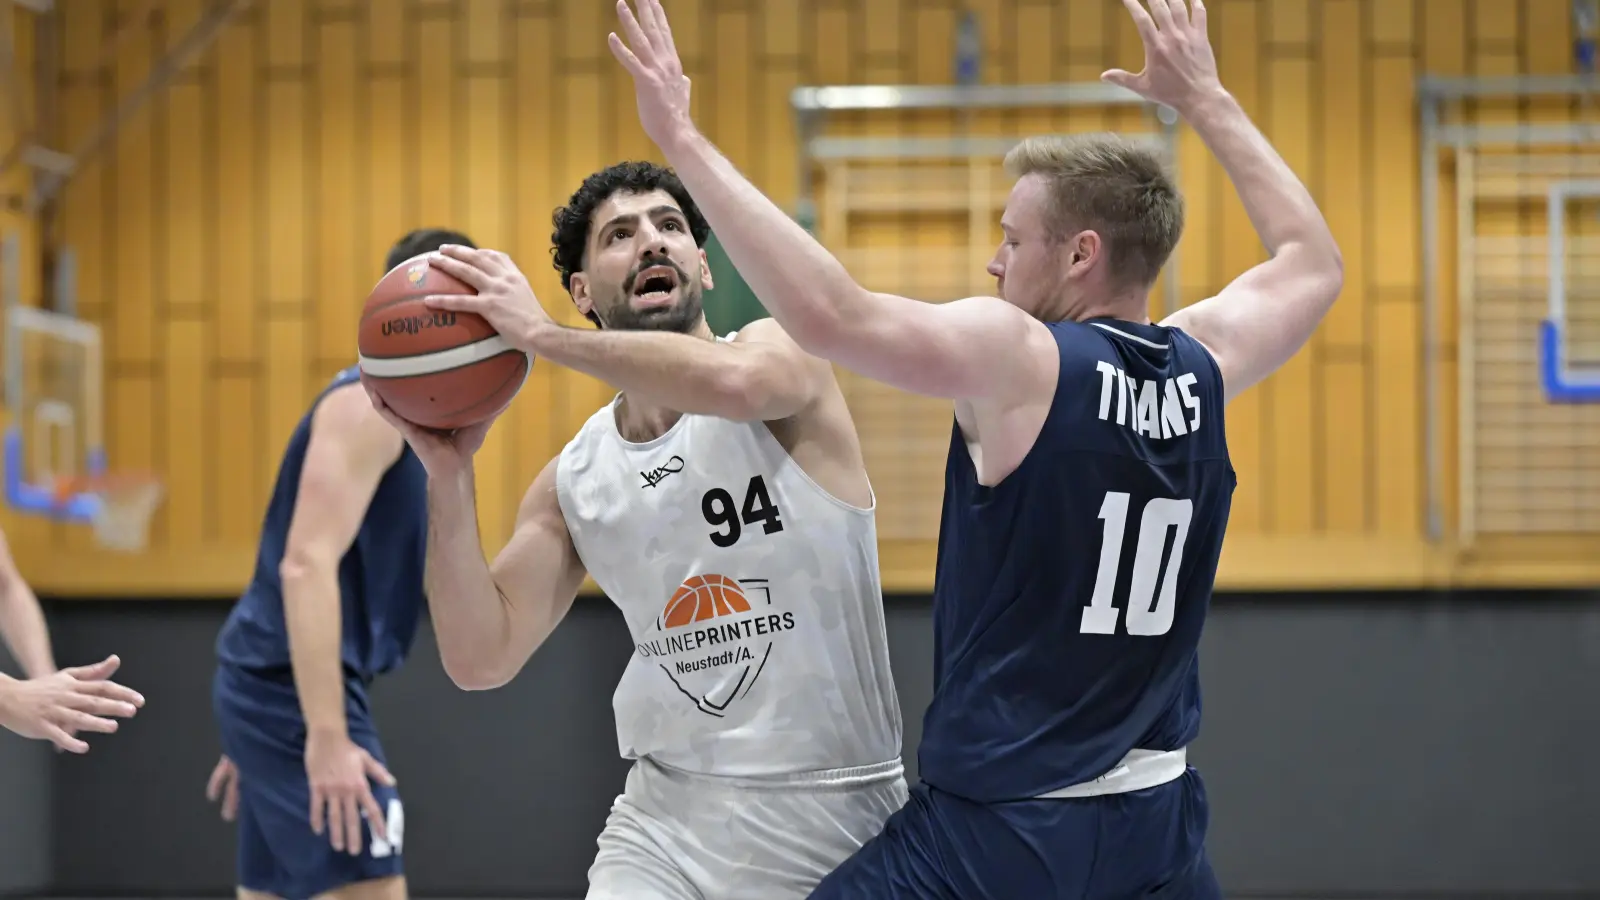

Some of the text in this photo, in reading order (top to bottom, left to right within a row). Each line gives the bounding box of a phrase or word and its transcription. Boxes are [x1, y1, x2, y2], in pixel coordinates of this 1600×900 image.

[381, 311, 457, 336] molten
[1096, 360, 1200, 440] TITANS
[701, 475, 784, 547] 94
[1079, 491, 1193, 636] 10
[637, 612, 795, 657] ONLINEPRINTERS
[676, 646, 755, 674] Neustadt/A.
